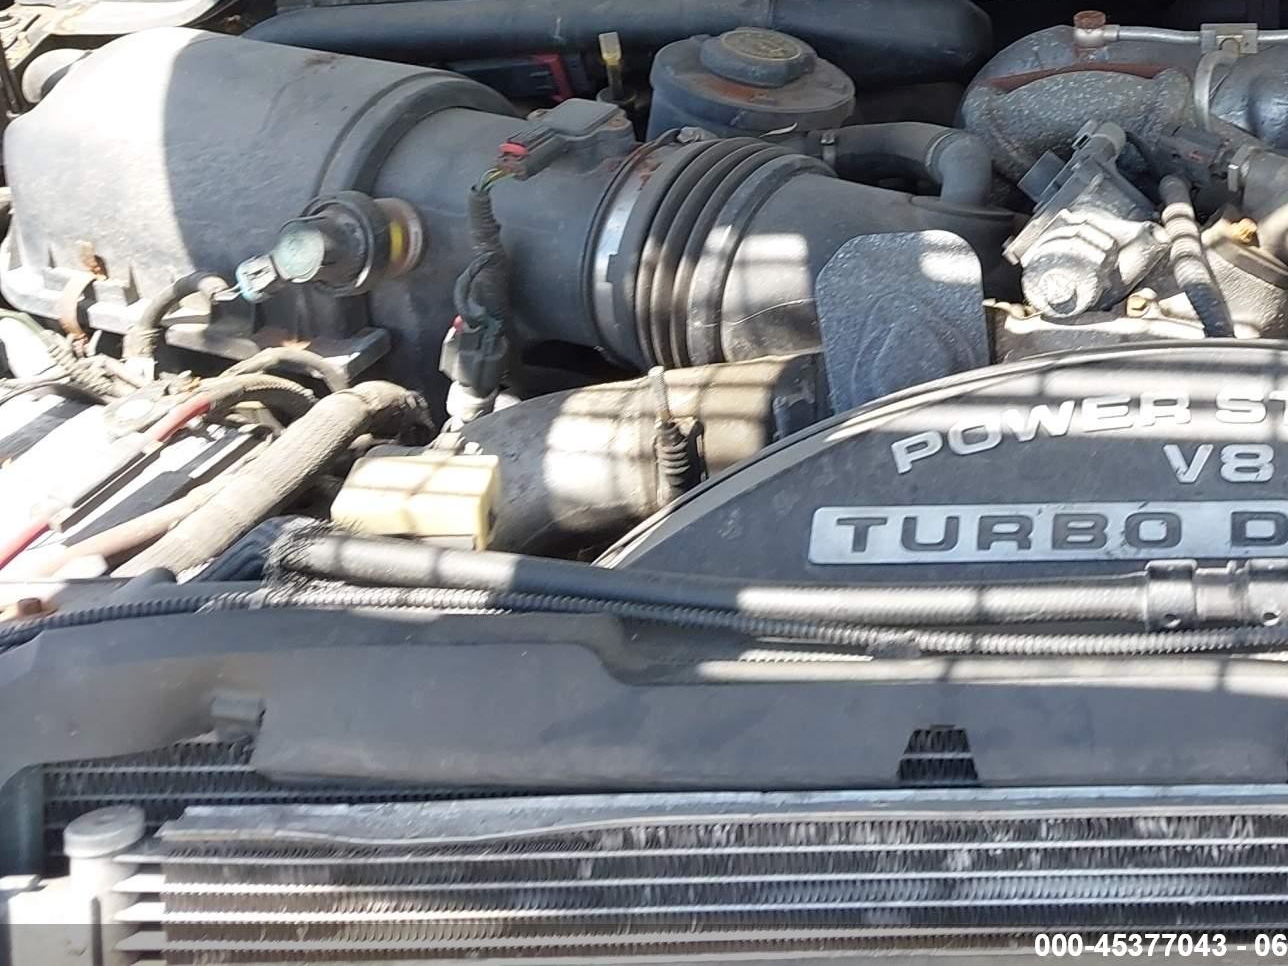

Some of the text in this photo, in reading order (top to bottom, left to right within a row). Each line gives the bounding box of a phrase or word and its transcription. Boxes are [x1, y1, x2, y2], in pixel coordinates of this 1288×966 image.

[891, 393, 1192, 474] POWER
[1163, 443, 1275, 484] V8
[835, 511, 1182, 552] TURBO
